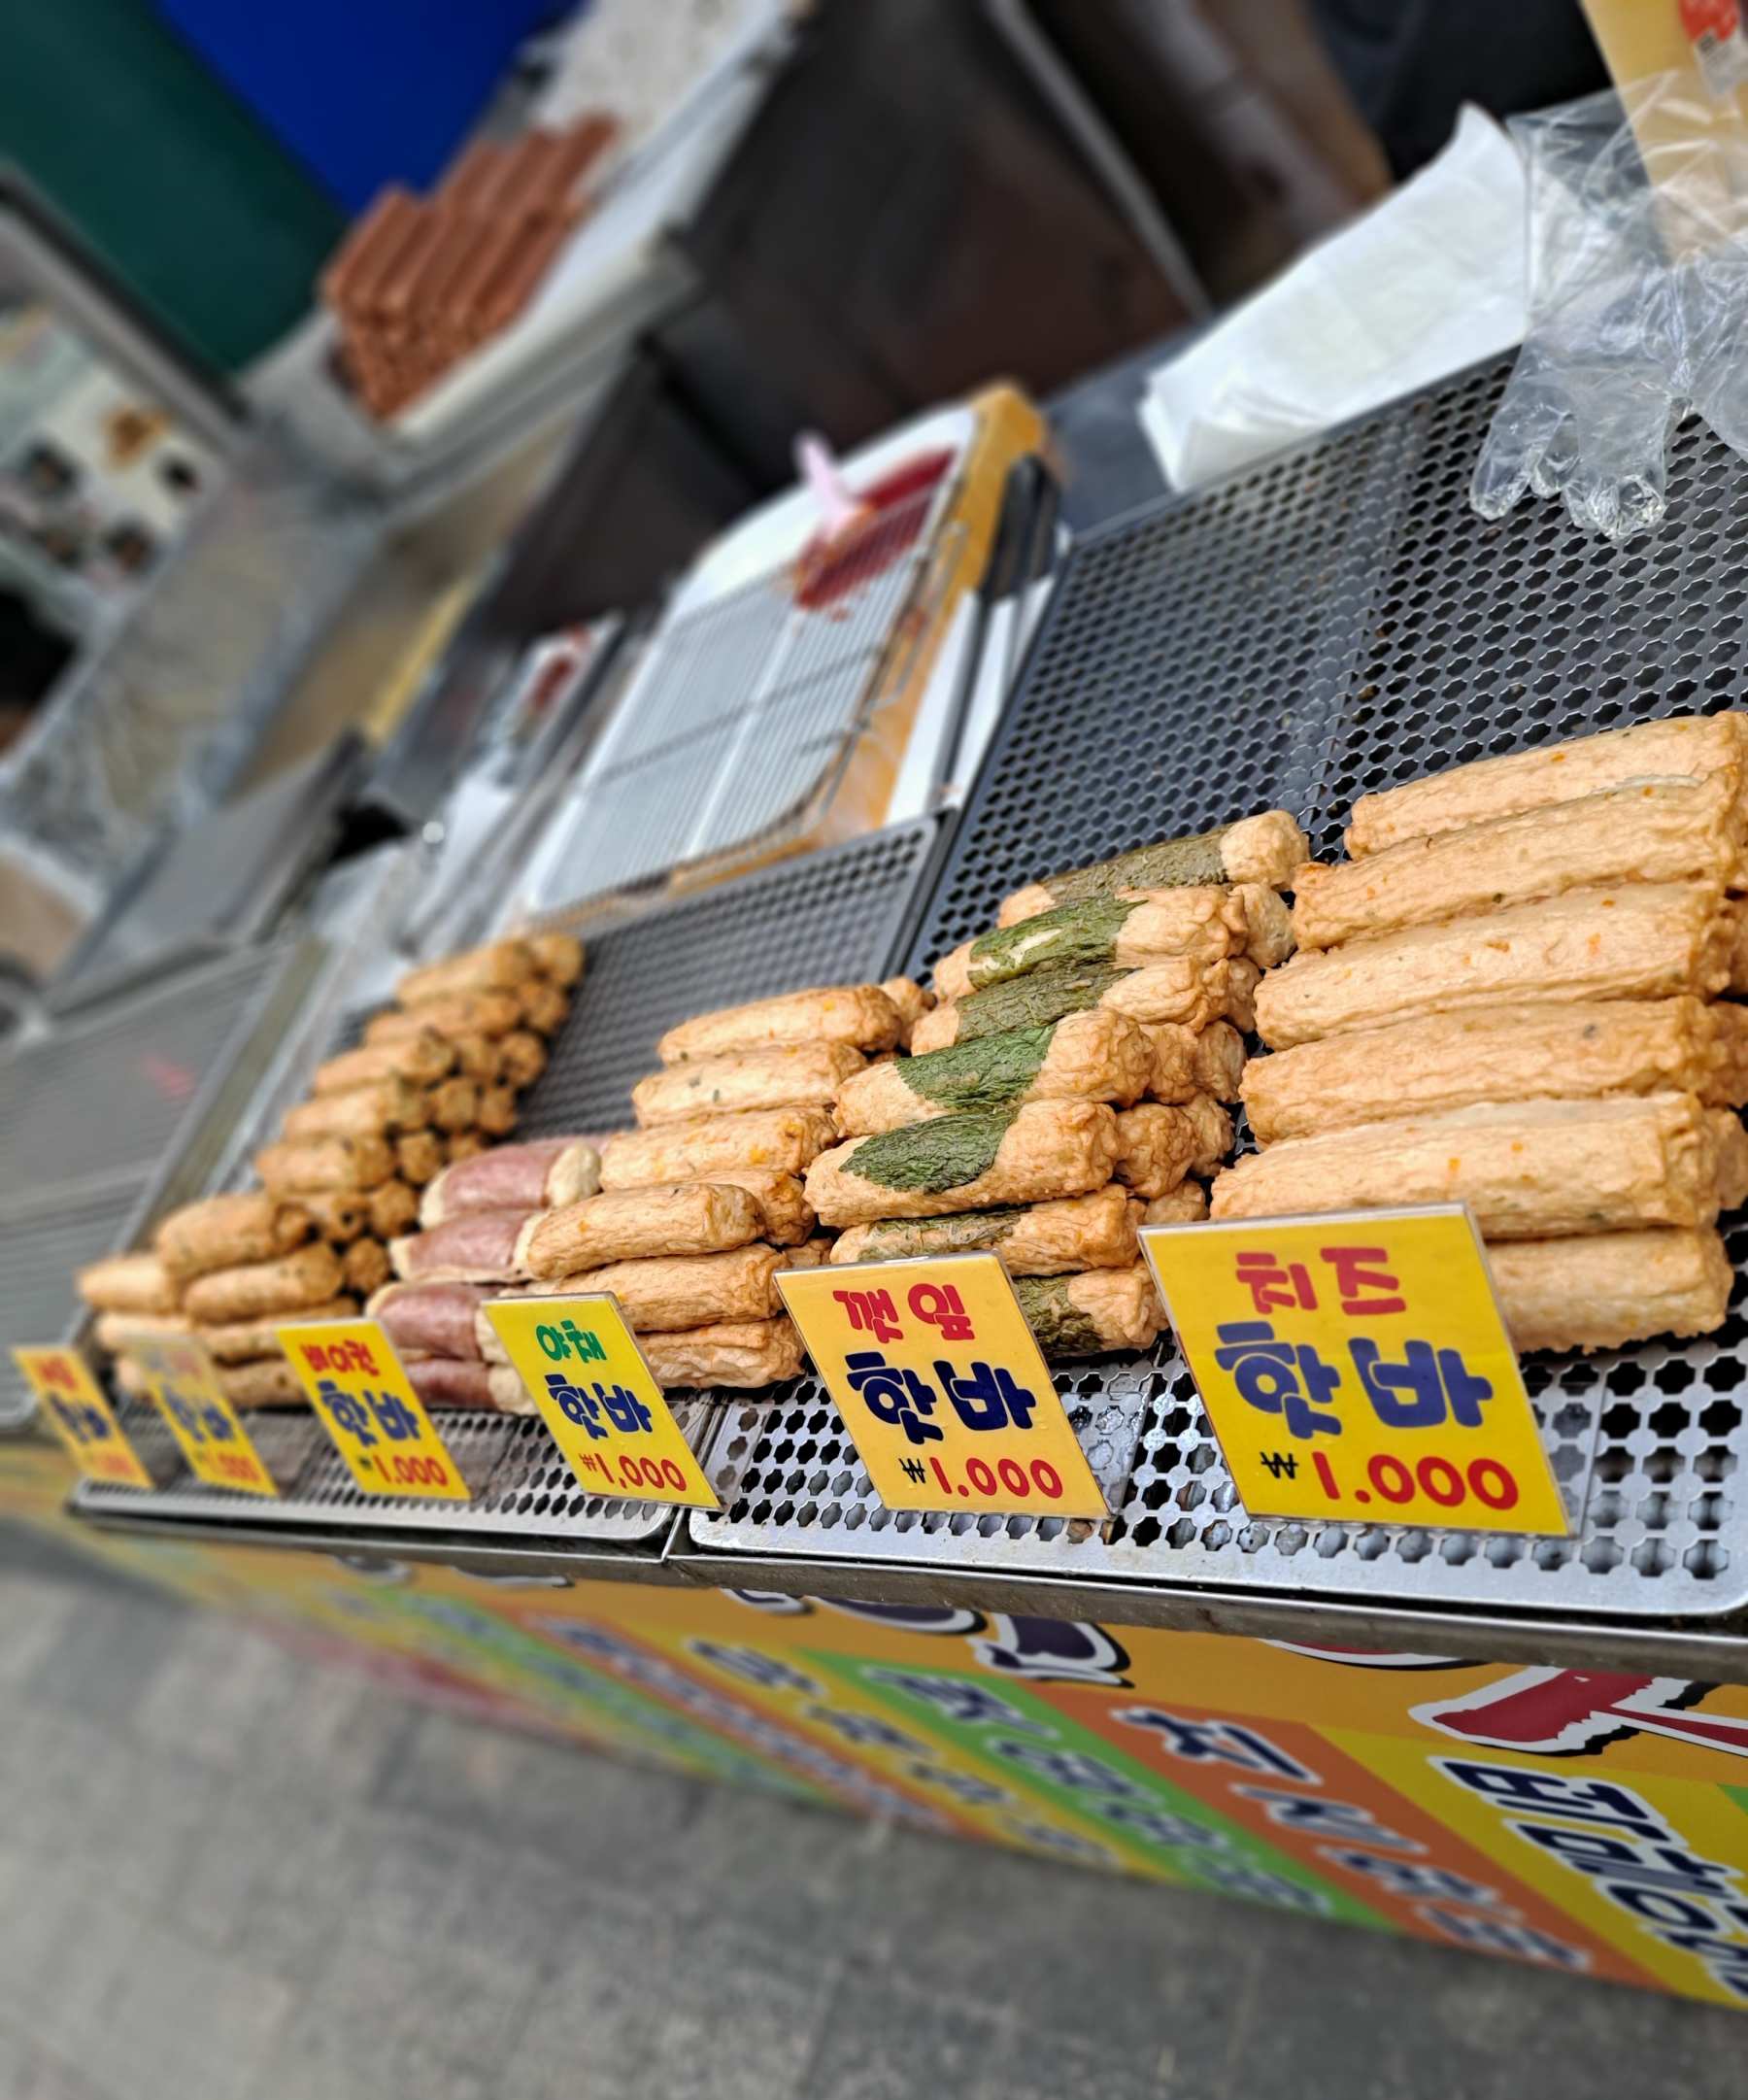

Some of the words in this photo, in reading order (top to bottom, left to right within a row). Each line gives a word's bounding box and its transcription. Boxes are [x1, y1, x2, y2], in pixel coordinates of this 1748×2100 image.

[832, 1283, 975, 1343] 깻잎
[1235, 1247, 1406, 1316] 치즈
[536, 1320, 607, 1363] 야채
[317, 1379, 421, 1447] 핫바
[544, 1373, 654, 1440] 핫바
[845, 1351, 1036, 1444] 핫바
[1214, 1321, 1494, 1439] 핫바
